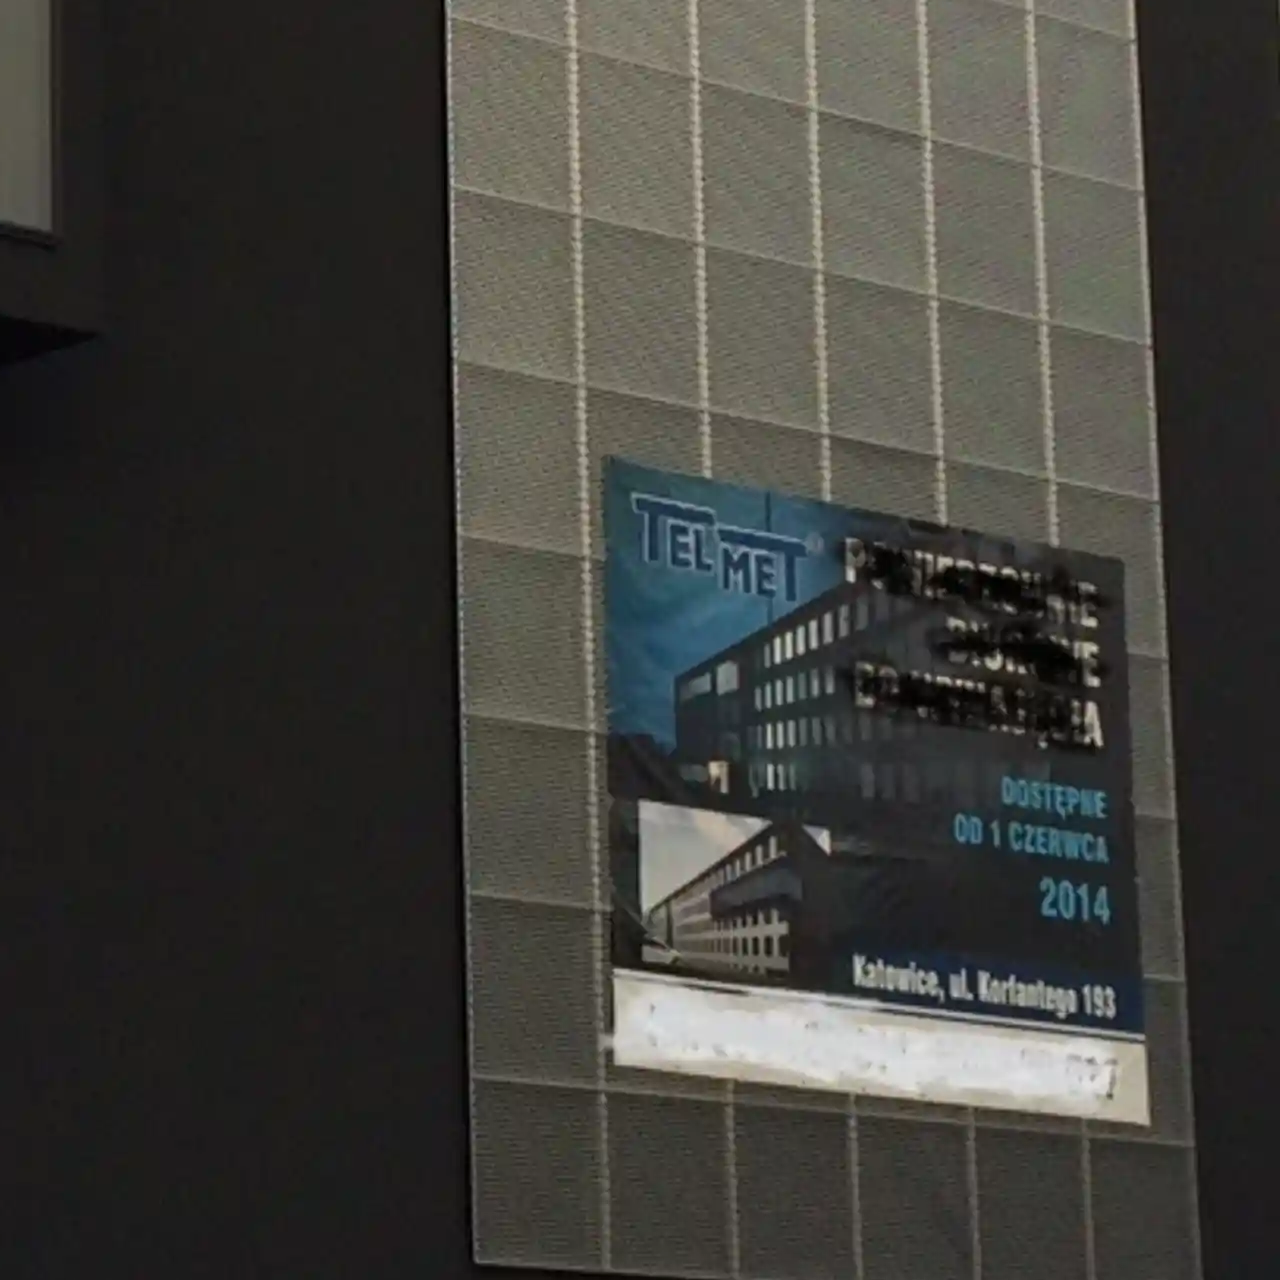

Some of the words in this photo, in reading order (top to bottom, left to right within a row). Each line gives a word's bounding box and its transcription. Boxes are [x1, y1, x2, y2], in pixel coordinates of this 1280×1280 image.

[1001, 775, 1108, 820] DOSTĘPNE
[954, 812, 983, 845] OD
[990, 819, 1001, 848] 1
[1008, 820, 1109, 864] CZERWCA
[1039, 875, 1111, 926] 2014
[852, 952, 945, 1004] Katowice,
[949, 967, 974, 1001] ul.
[977, 969, 1078, 1019] Korfantego
[1082, 983, 1117, 1019] 193
